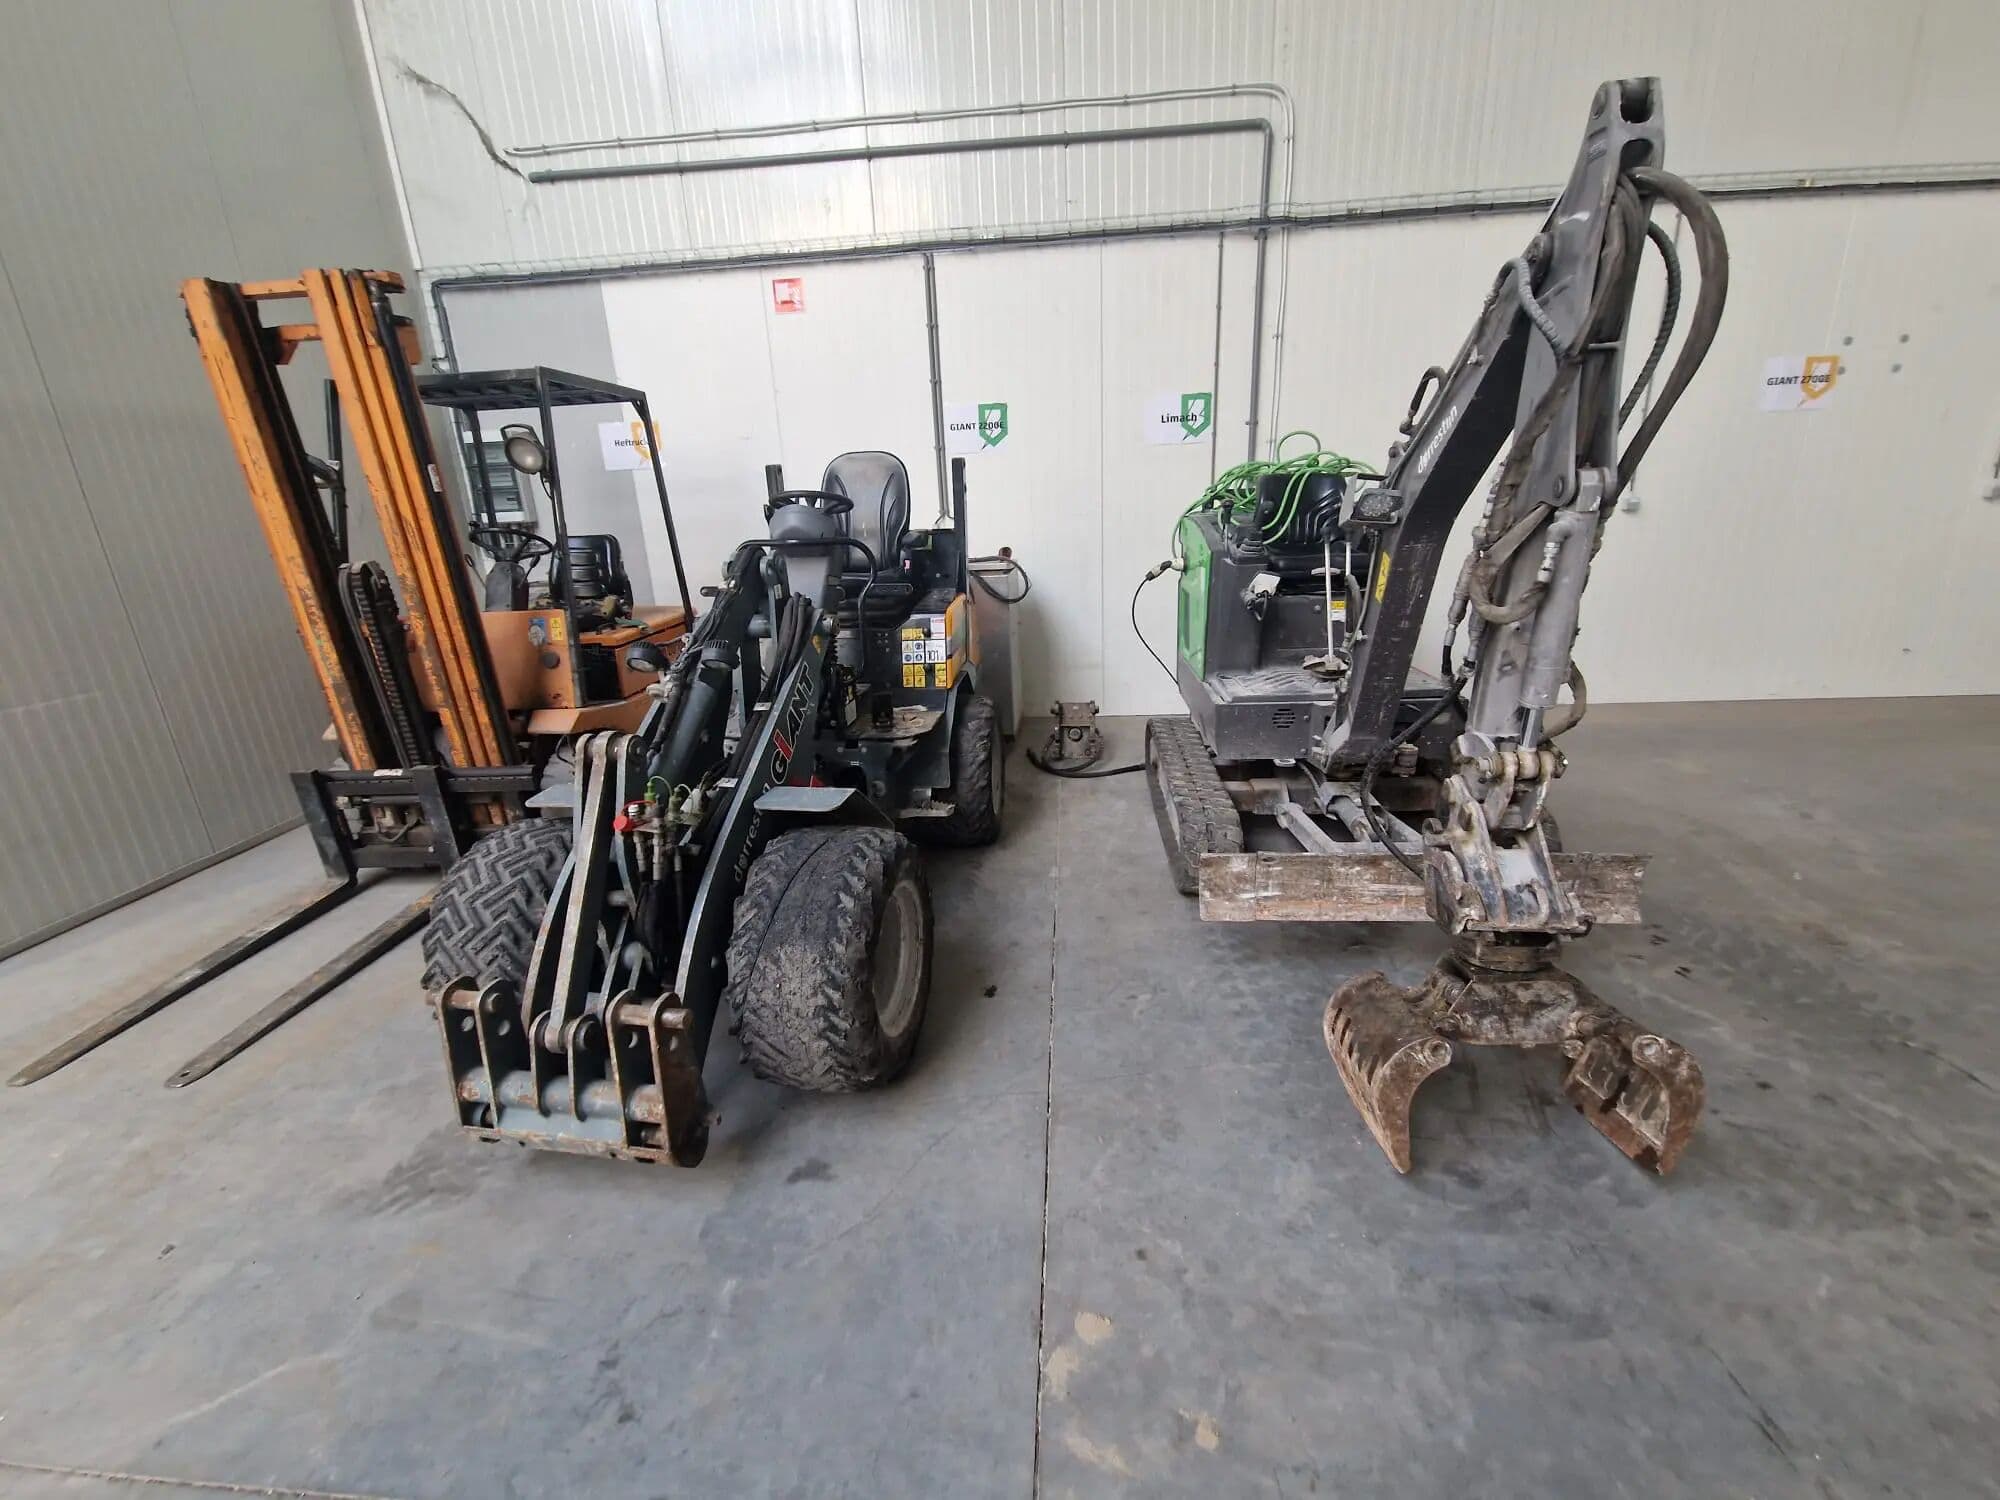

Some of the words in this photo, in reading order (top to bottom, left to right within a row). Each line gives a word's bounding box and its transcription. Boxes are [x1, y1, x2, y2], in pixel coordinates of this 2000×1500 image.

[1767, 376, 1799, 386] GIANT
[1161, 412, 1198, 423] Limach
[950, 422, 976, 431] GIANT
[770, 660, 814, 785] GIANT
